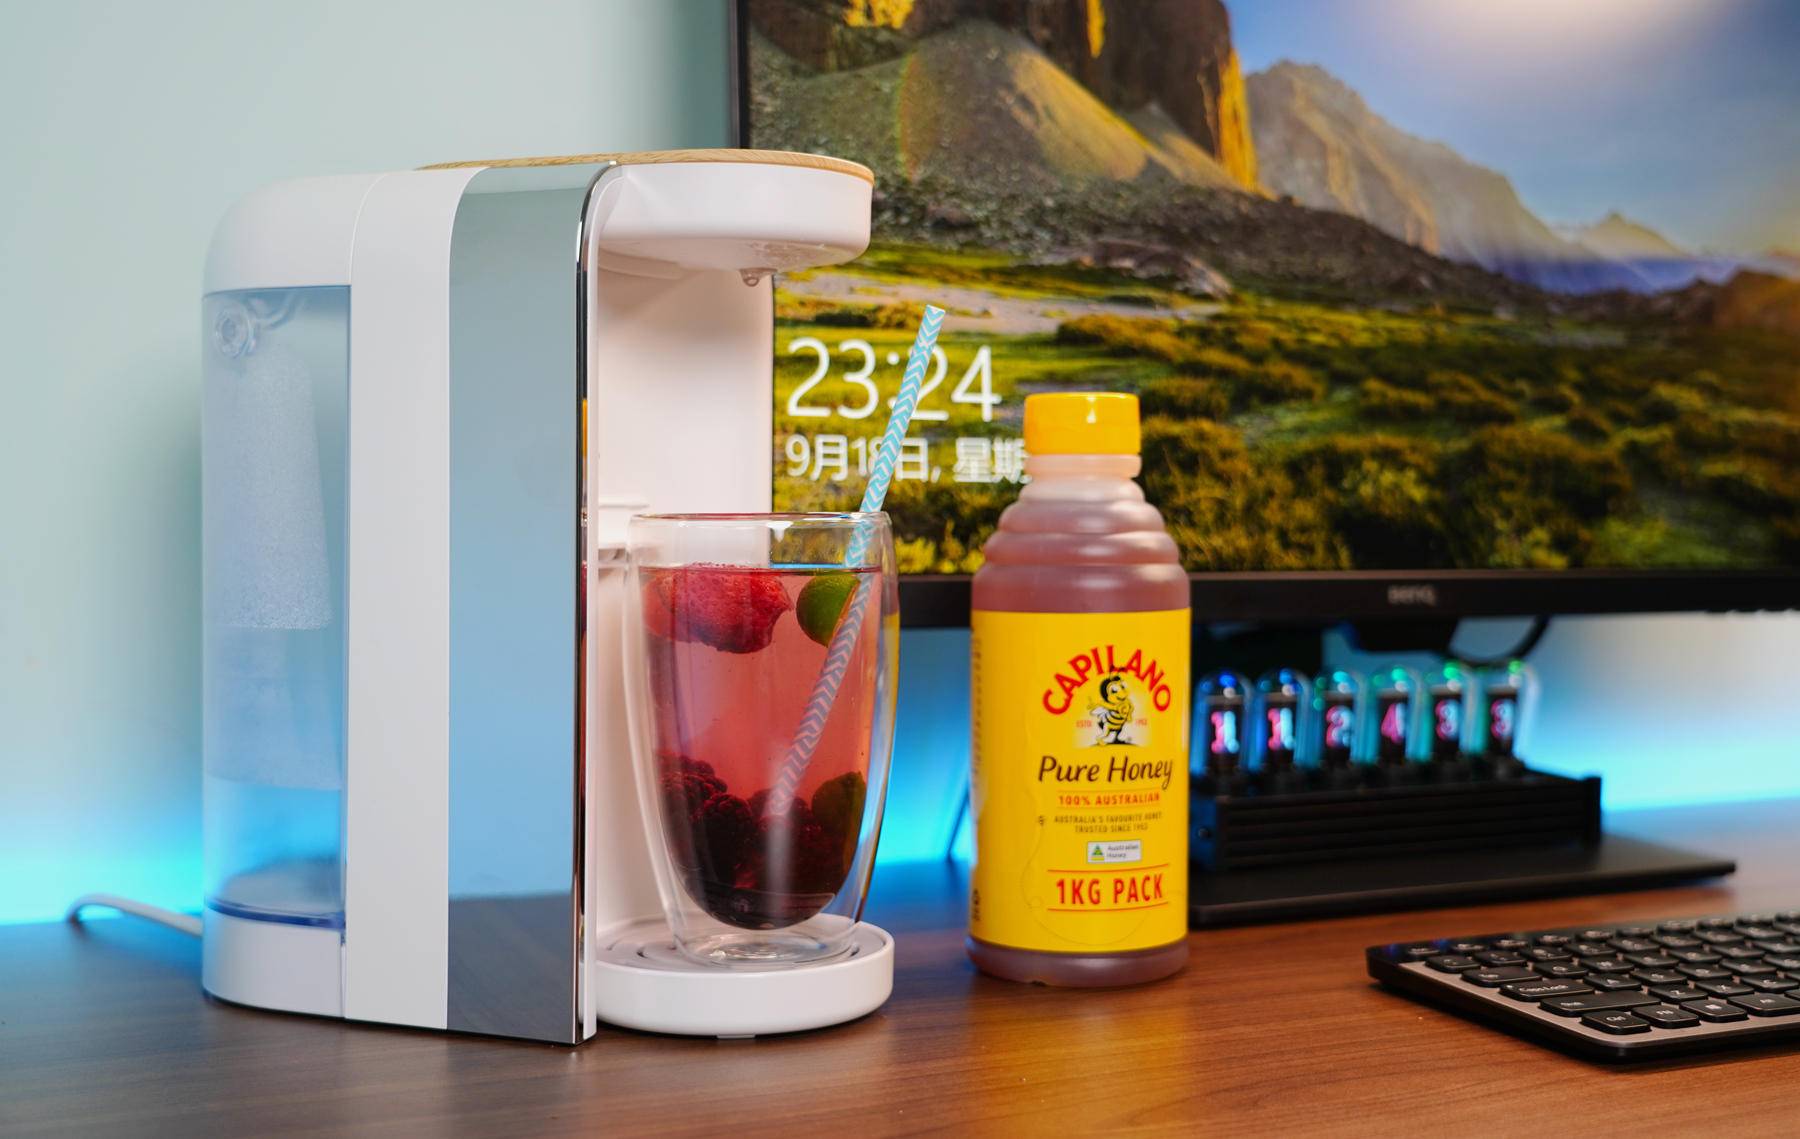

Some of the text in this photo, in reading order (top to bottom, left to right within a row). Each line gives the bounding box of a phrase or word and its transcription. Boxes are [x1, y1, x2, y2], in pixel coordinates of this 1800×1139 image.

[787, 336, 1002, 422] 23:24
[1042, 645, 1171, 715] CAPILANO
[1038, 755, 1173, 790] Pure Honey
[1058, 792, 1160, 805] 100% AUSTRALIAN
[1075, 825, 1108, 833] TRUSTED
[1110, 824, 1131, 832] SINCE
[1056, 873, 1163, 905] 1KG PACK
